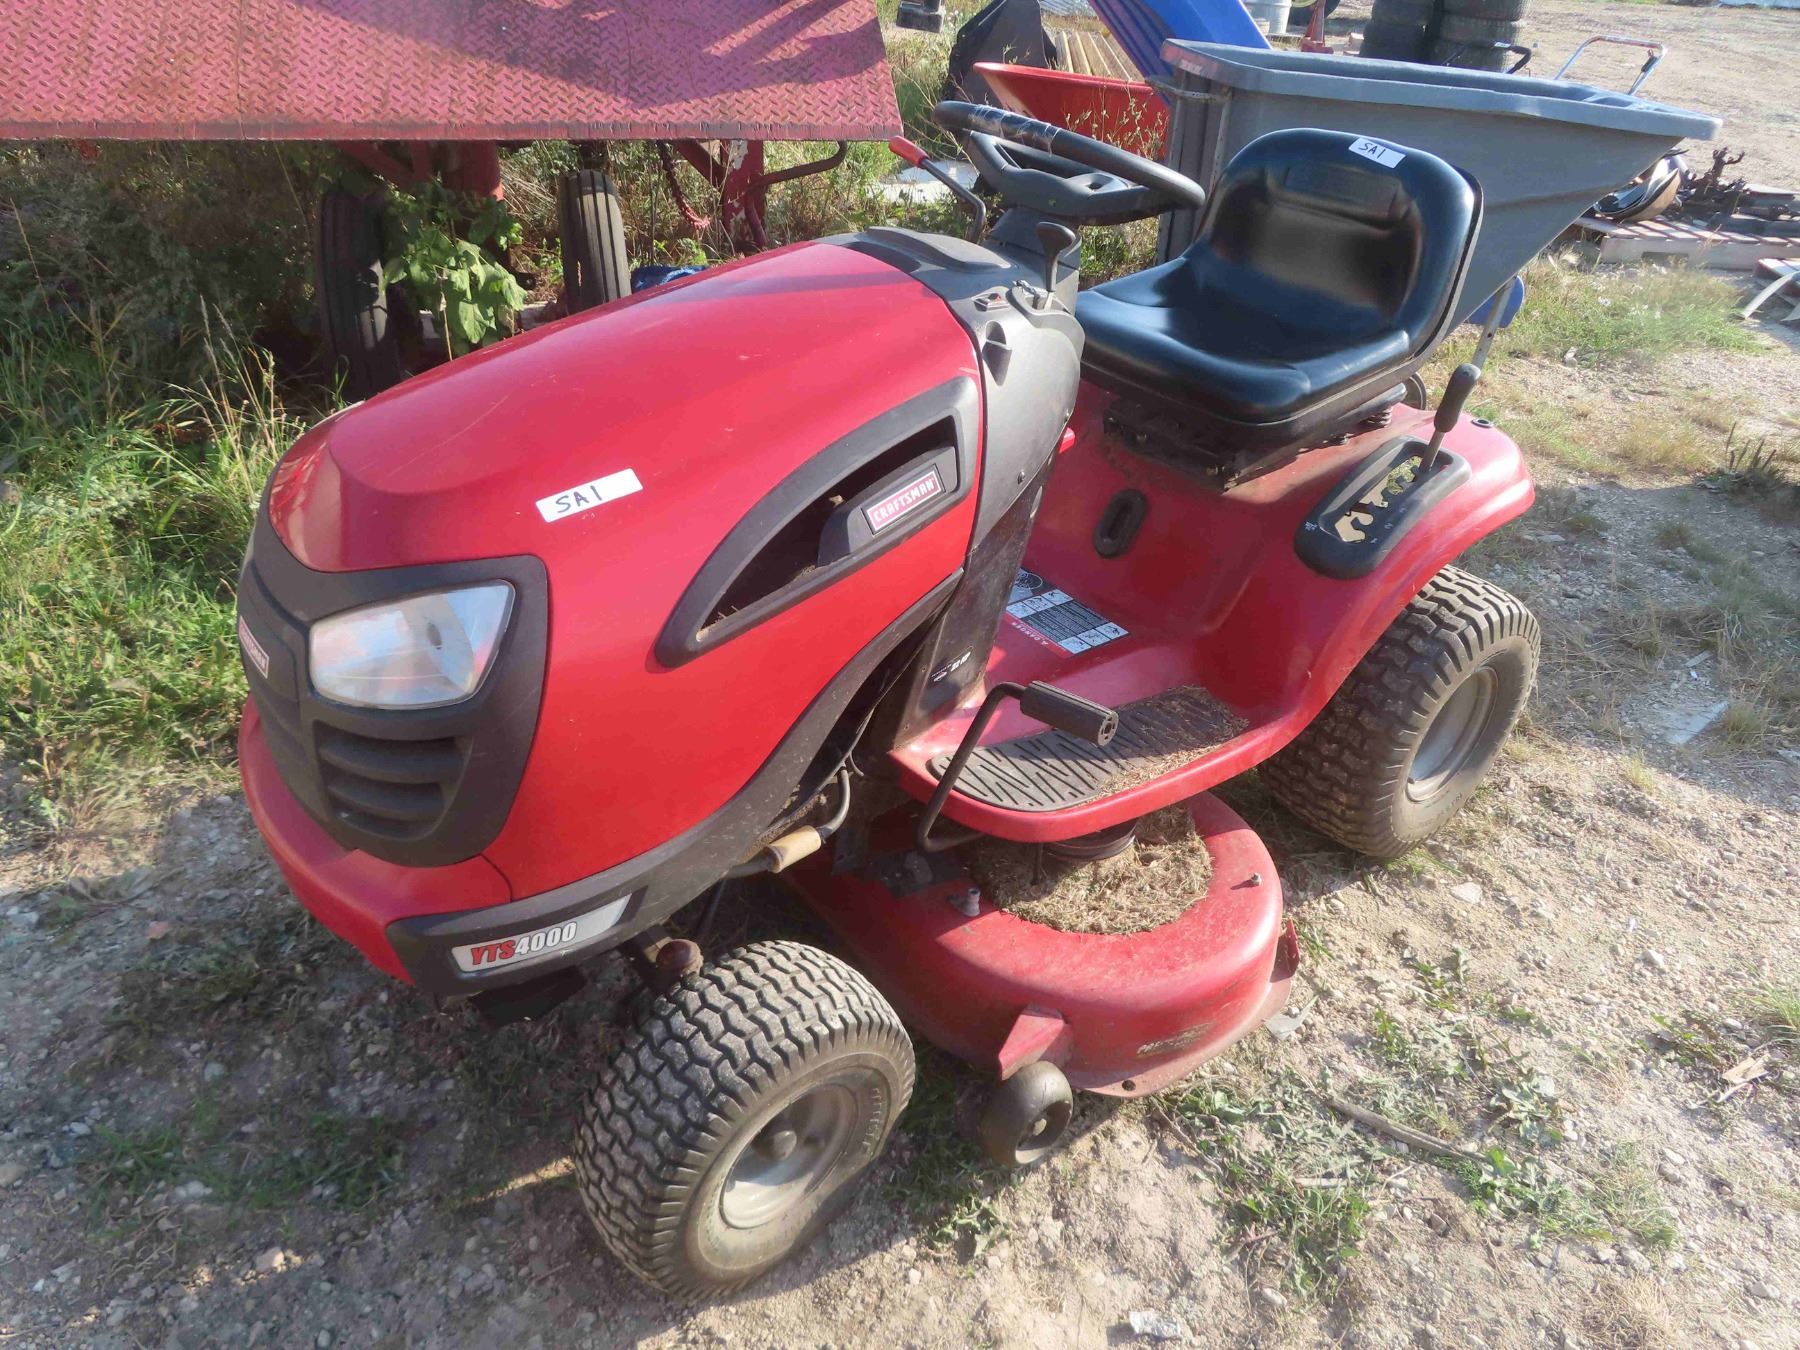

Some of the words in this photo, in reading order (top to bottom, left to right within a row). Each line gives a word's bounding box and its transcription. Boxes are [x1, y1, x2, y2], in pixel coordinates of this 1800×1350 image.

[872, 477, 936, 523] CRAFTSMAN
[1011, 621, 1041, 642] DANGER
[470, 921, 578, 966] YTS4000
